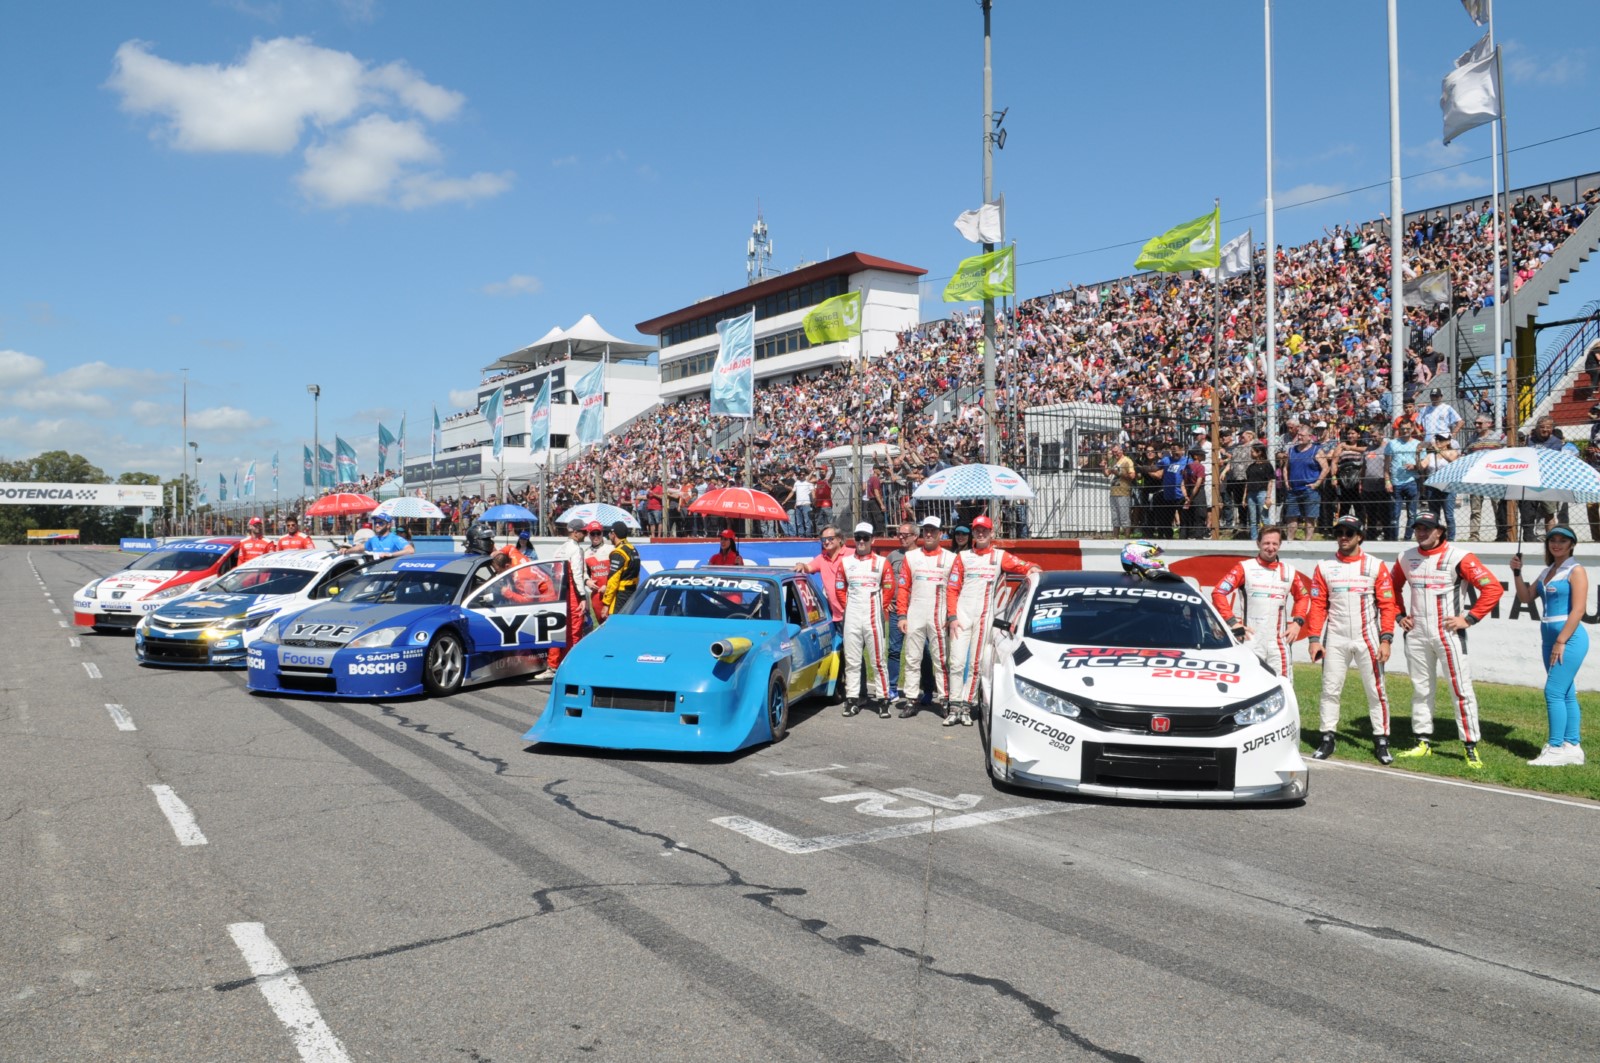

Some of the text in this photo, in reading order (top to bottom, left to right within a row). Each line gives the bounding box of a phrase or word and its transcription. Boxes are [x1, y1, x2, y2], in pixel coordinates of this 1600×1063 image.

[1485, 462, 1530, 470] PALADINI
[123, 541, 152, 549] INFINIA
[1032, 607, 1063, 621] 20
[291, 623, 358, 637] YPF
[282, 652, 325, 666] Focus
[366, 653, 400, 662] SACHS
[1061, 656, 1240, 673] TC2000
[348, 662, 395, 675] BOSCH
[1151, 668, 1241, 684] 2020
[1001, 708, 1076, 746] SUPERTC2000
[1048, 738, 1071, 753] 2020
